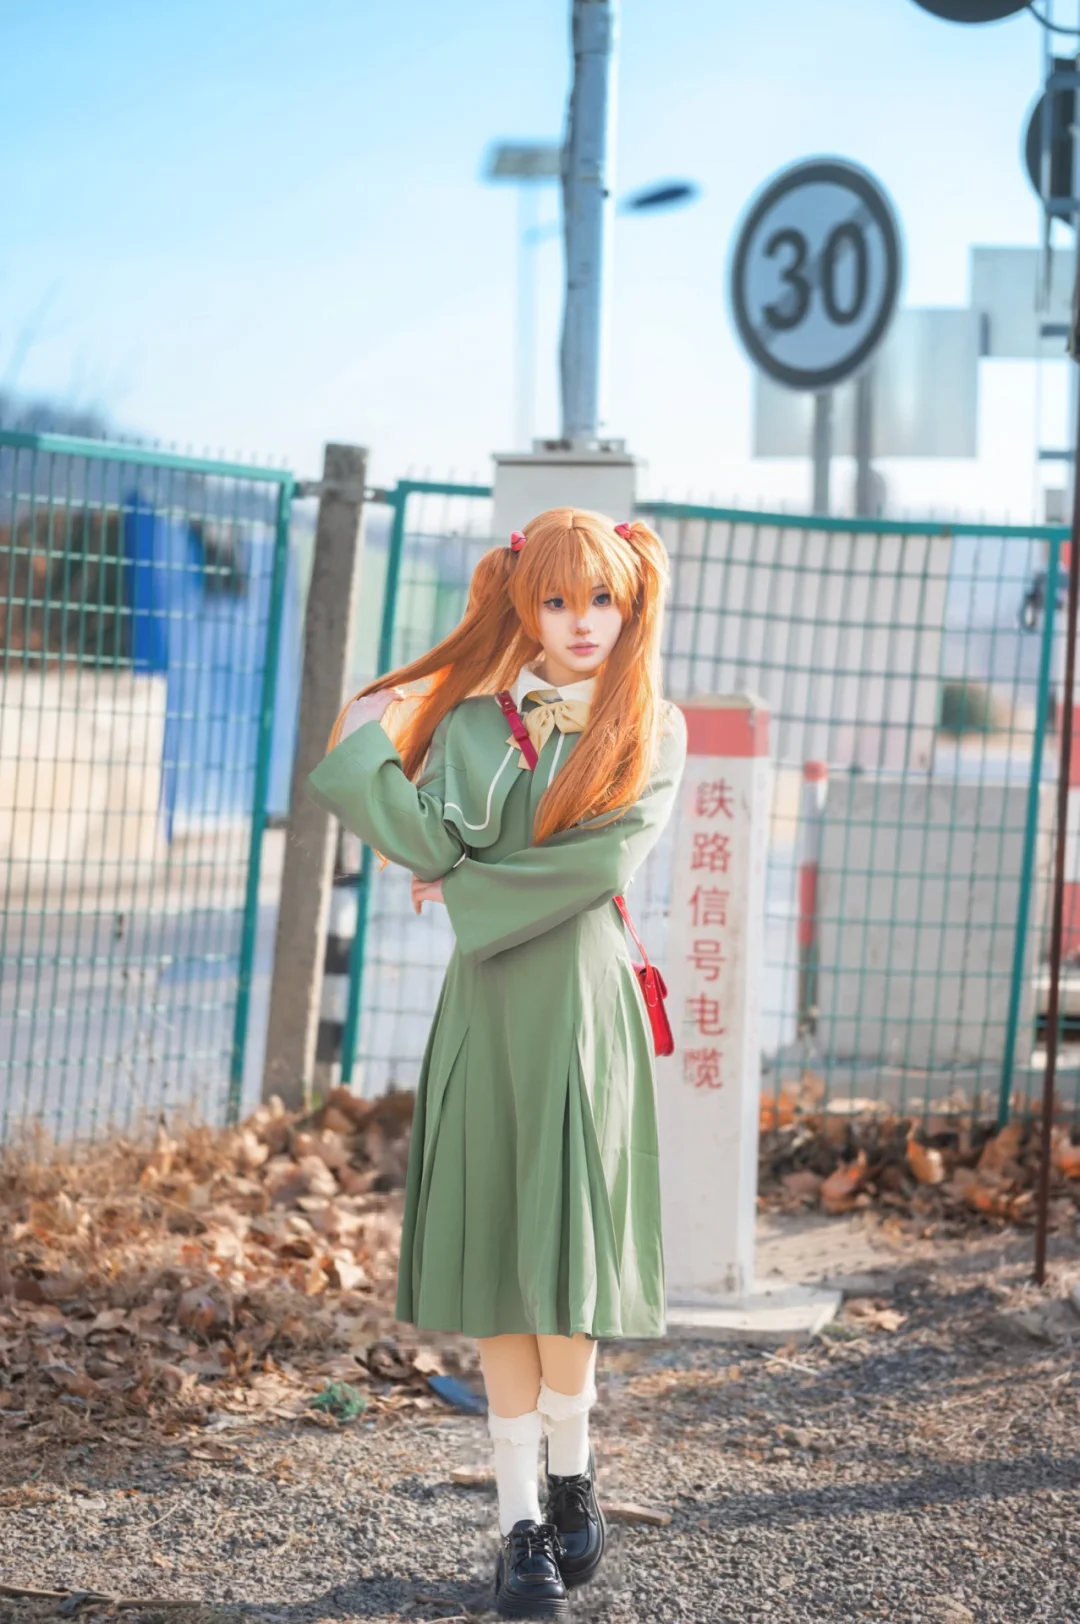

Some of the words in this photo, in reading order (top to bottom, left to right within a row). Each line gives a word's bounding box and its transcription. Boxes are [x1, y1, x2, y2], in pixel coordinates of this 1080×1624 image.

[763, 221, 868, 331] 30
[683, 777, 734, 1089] 铁路信号电缆
